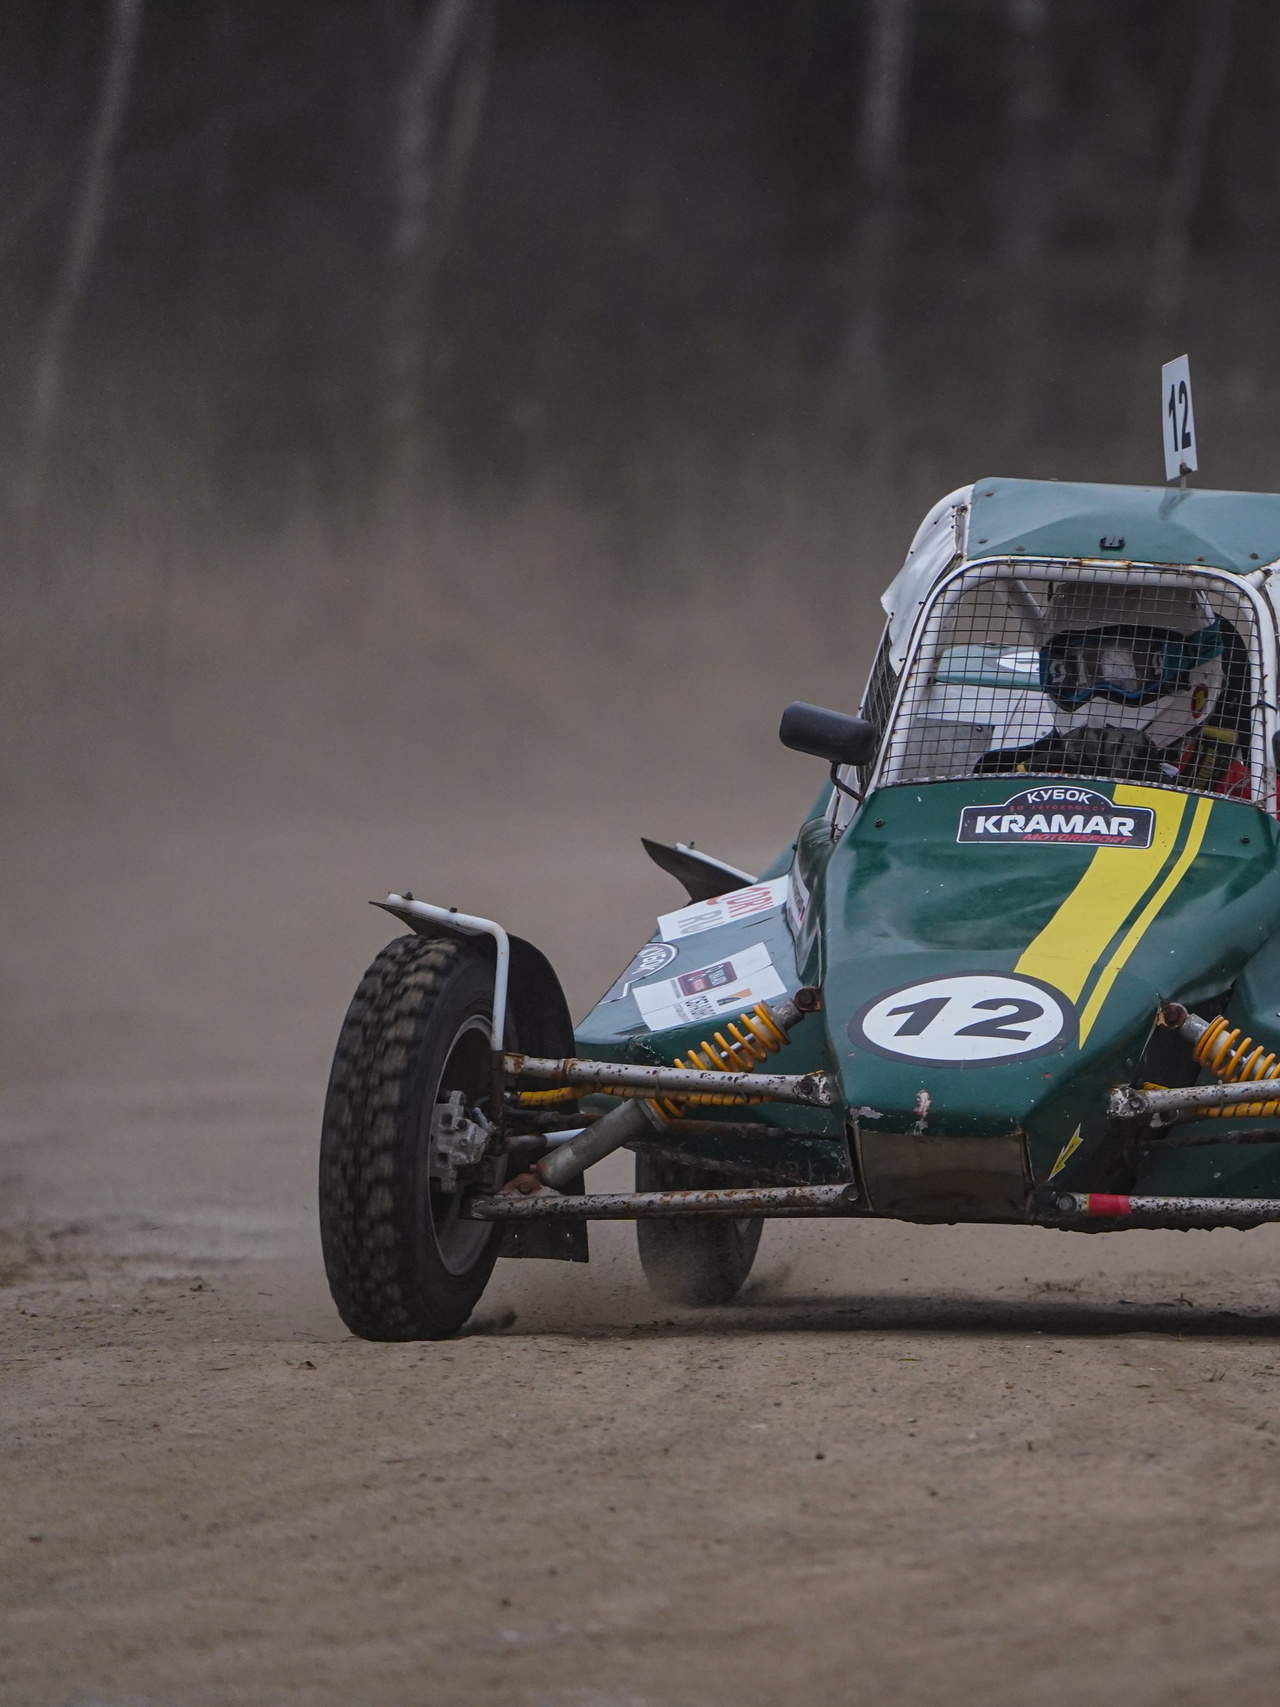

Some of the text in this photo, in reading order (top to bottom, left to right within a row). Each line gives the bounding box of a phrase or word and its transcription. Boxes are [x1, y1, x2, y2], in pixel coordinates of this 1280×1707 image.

[1168, 380, 1192, 452] 12
[1027, 789, 1093, 804] КУБОК
[975, 814, 1135, 836] KRAMAR
[1022, 833, 1133, 844] MOTORSPORT
[885, 997, 1045, 1041] 12
